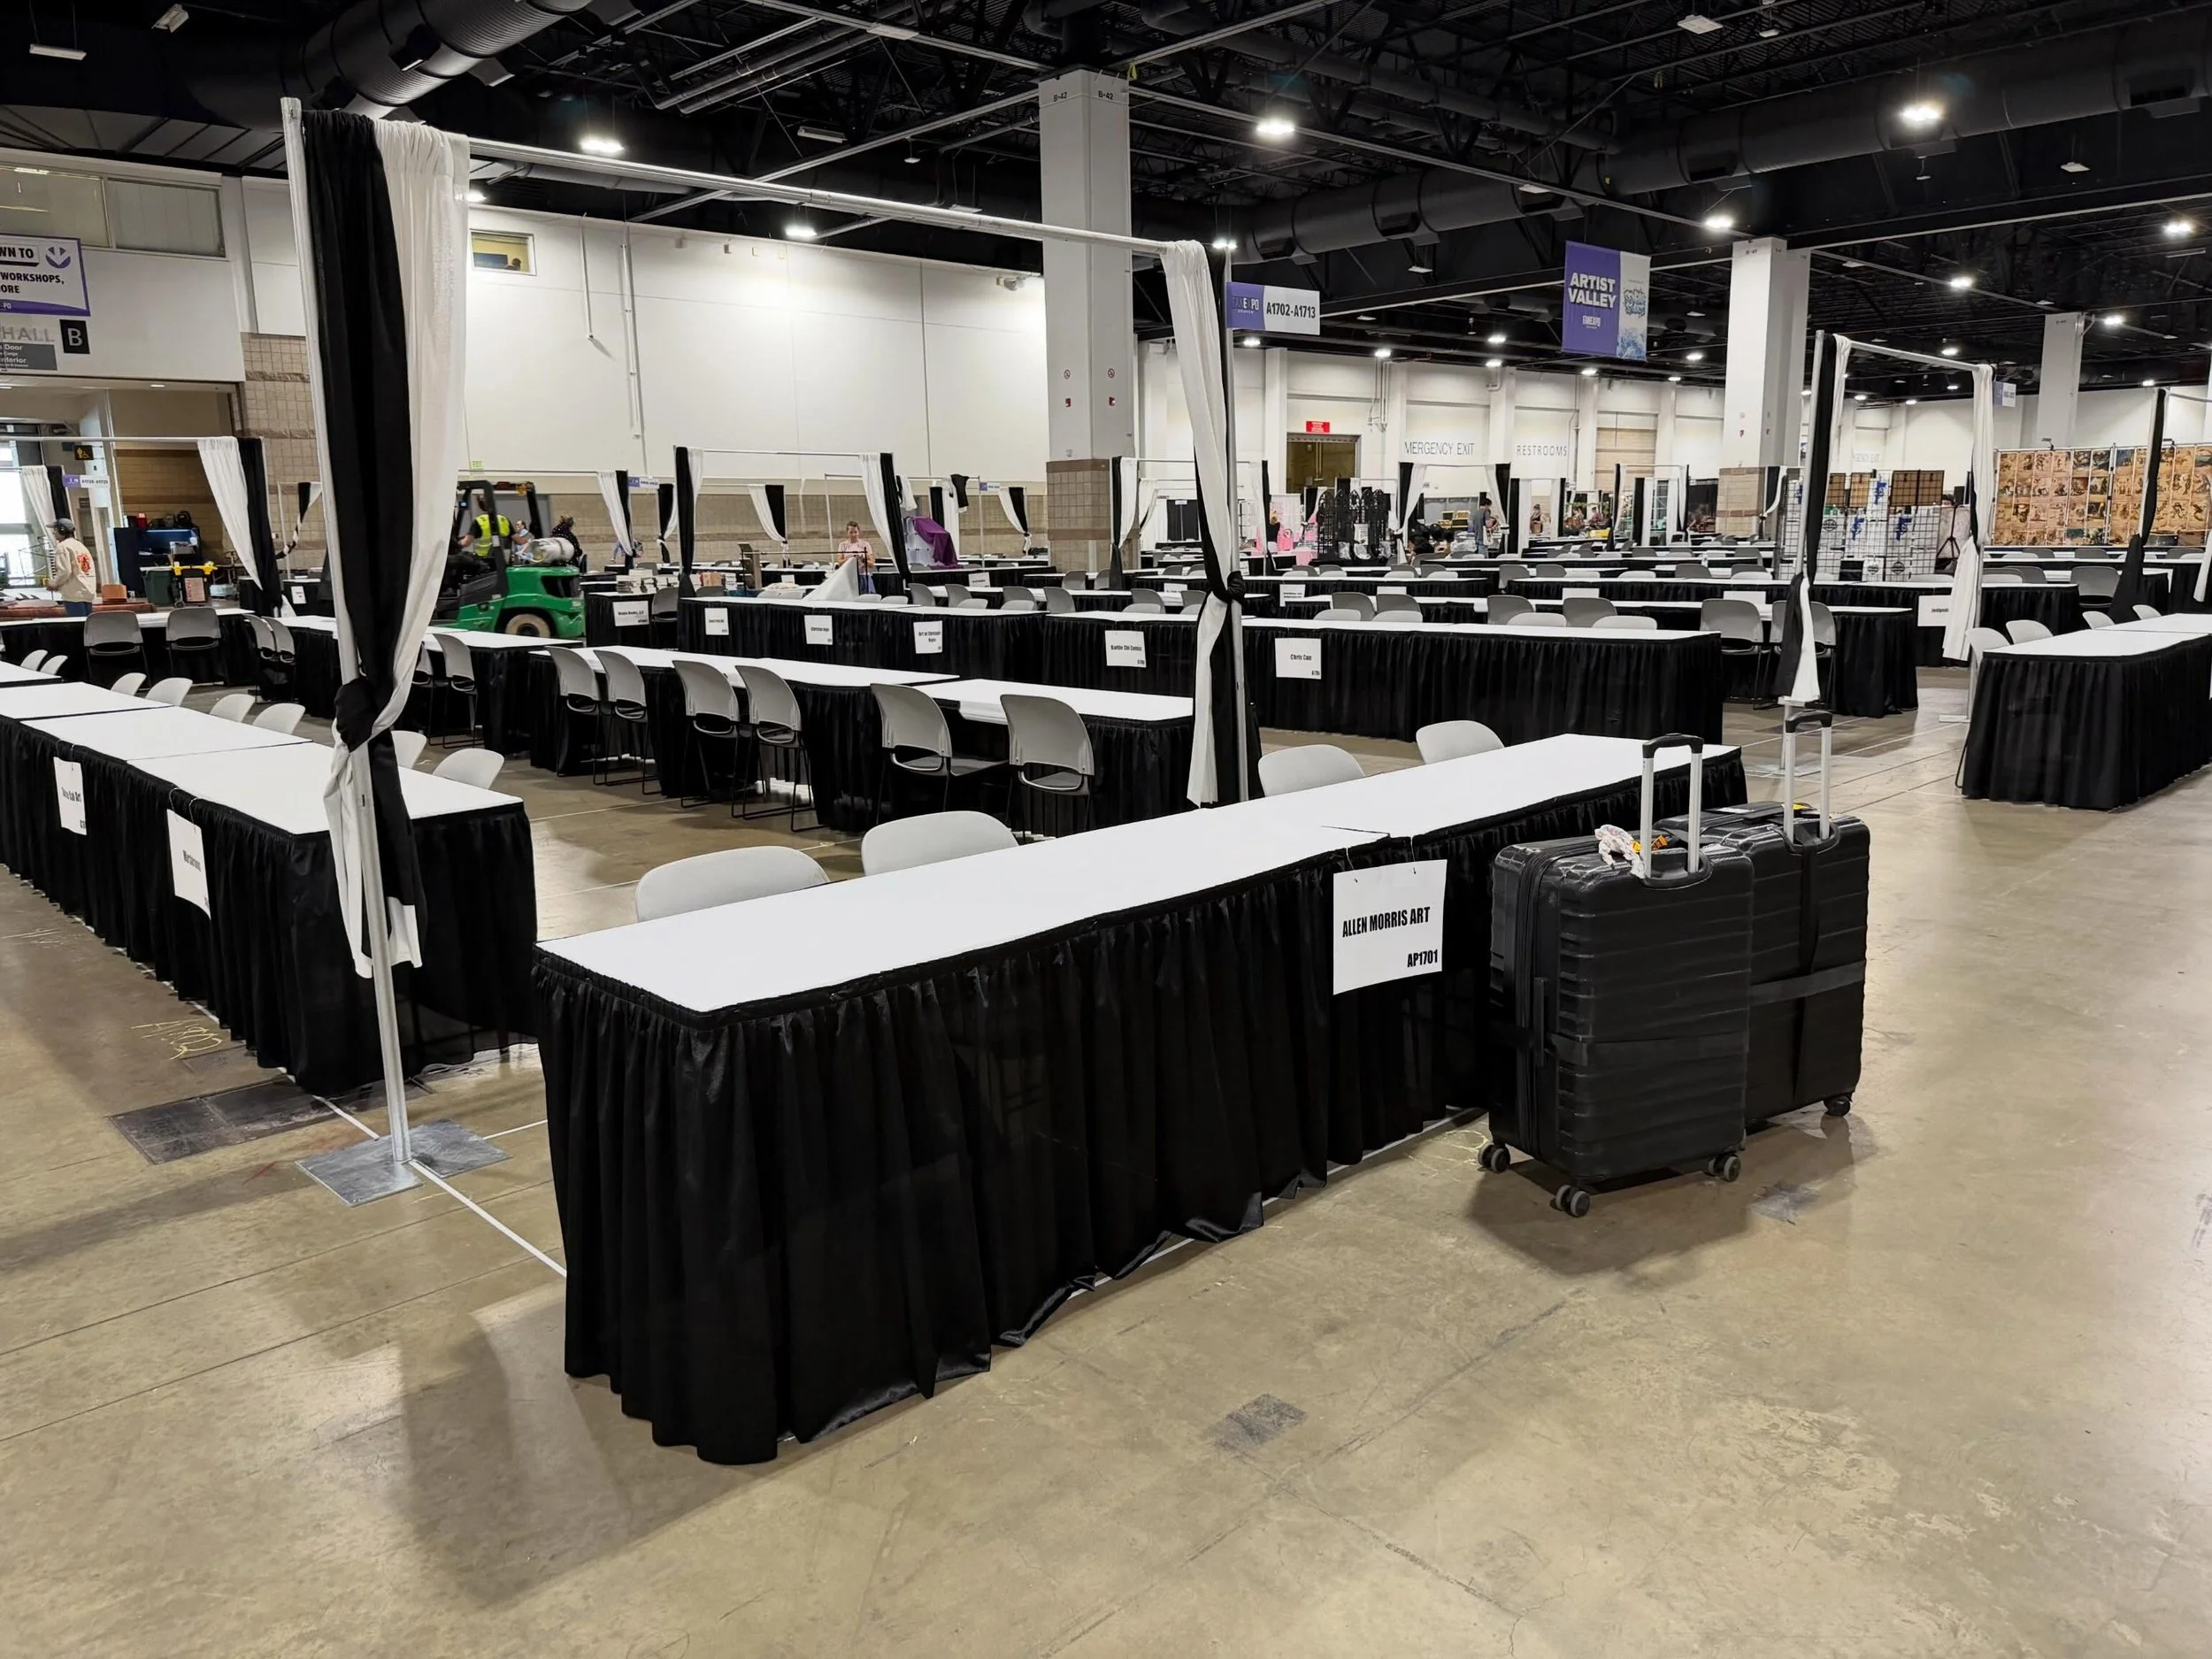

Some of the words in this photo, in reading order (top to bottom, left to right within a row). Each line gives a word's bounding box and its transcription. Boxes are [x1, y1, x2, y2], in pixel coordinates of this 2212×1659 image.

[19, 249, 34, 258] TO
[1570, 273, 1616, 292] ARTIST
[1568, 288, 1617, 308] VALLEY
[1267, 302, 1316, 319] A1702-A1713
[3, 326, 55, 342] HALL
[67, 328, 82, 346] B
[1457, 442, 1474, 455] EXIT
[1517, 445, 1567, 456] RESTROOMS
[1342, 917, 1367, 938] ALLEN
[1370, 910, 1407, 932] MORRIS
[1409, 907, 1430, 925] ART
[1408, 949, 1438, 967] AP1701
